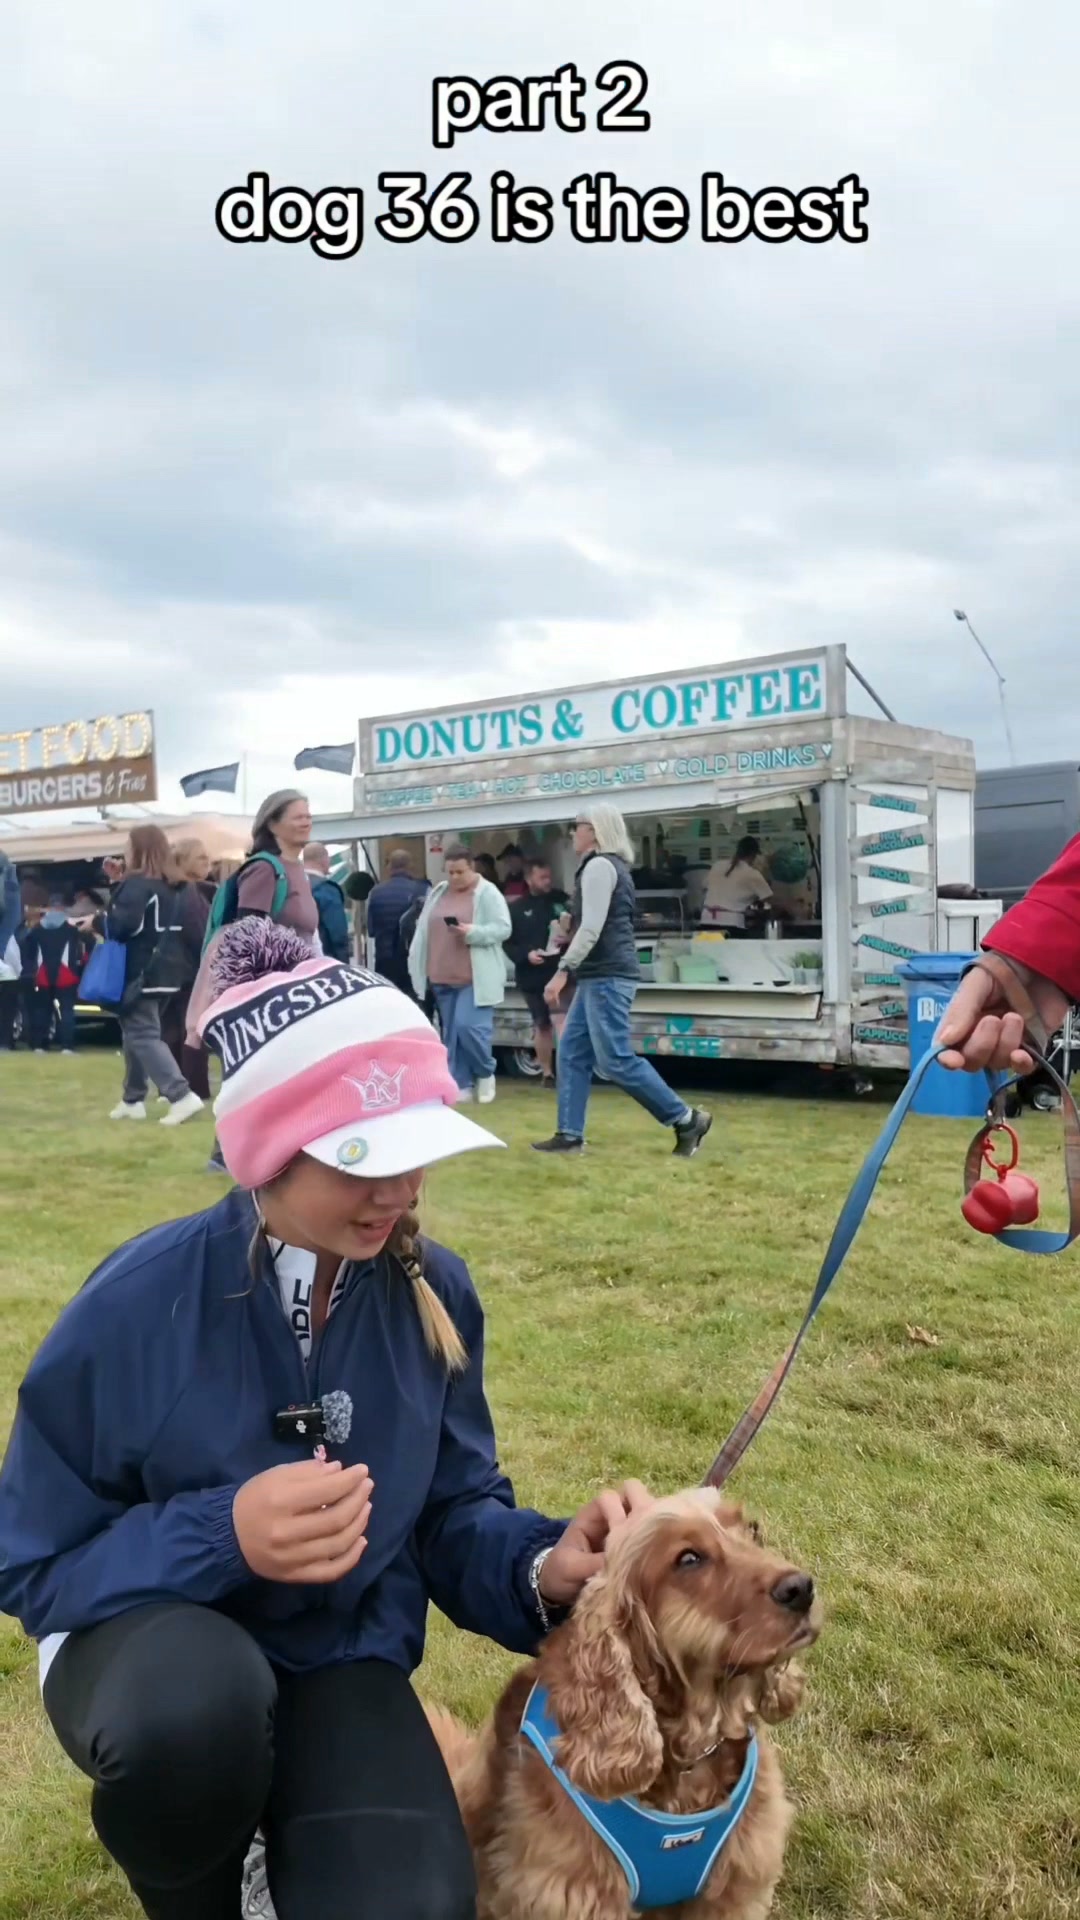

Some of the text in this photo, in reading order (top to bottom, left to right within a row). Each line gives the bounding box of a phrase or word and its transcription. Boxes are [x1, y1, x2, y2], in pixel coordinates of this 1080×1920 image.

[42, 713, 151, 768] FOOD
[376, 663, 821, 764] DONUTS & COFFEE
[495, 776, 528, 794] HOT
[538, 763, 646, 792] CHOCOLATE
[674, 755, 729, 778] COLD
[737, 745, 816, 771] DRINKS
